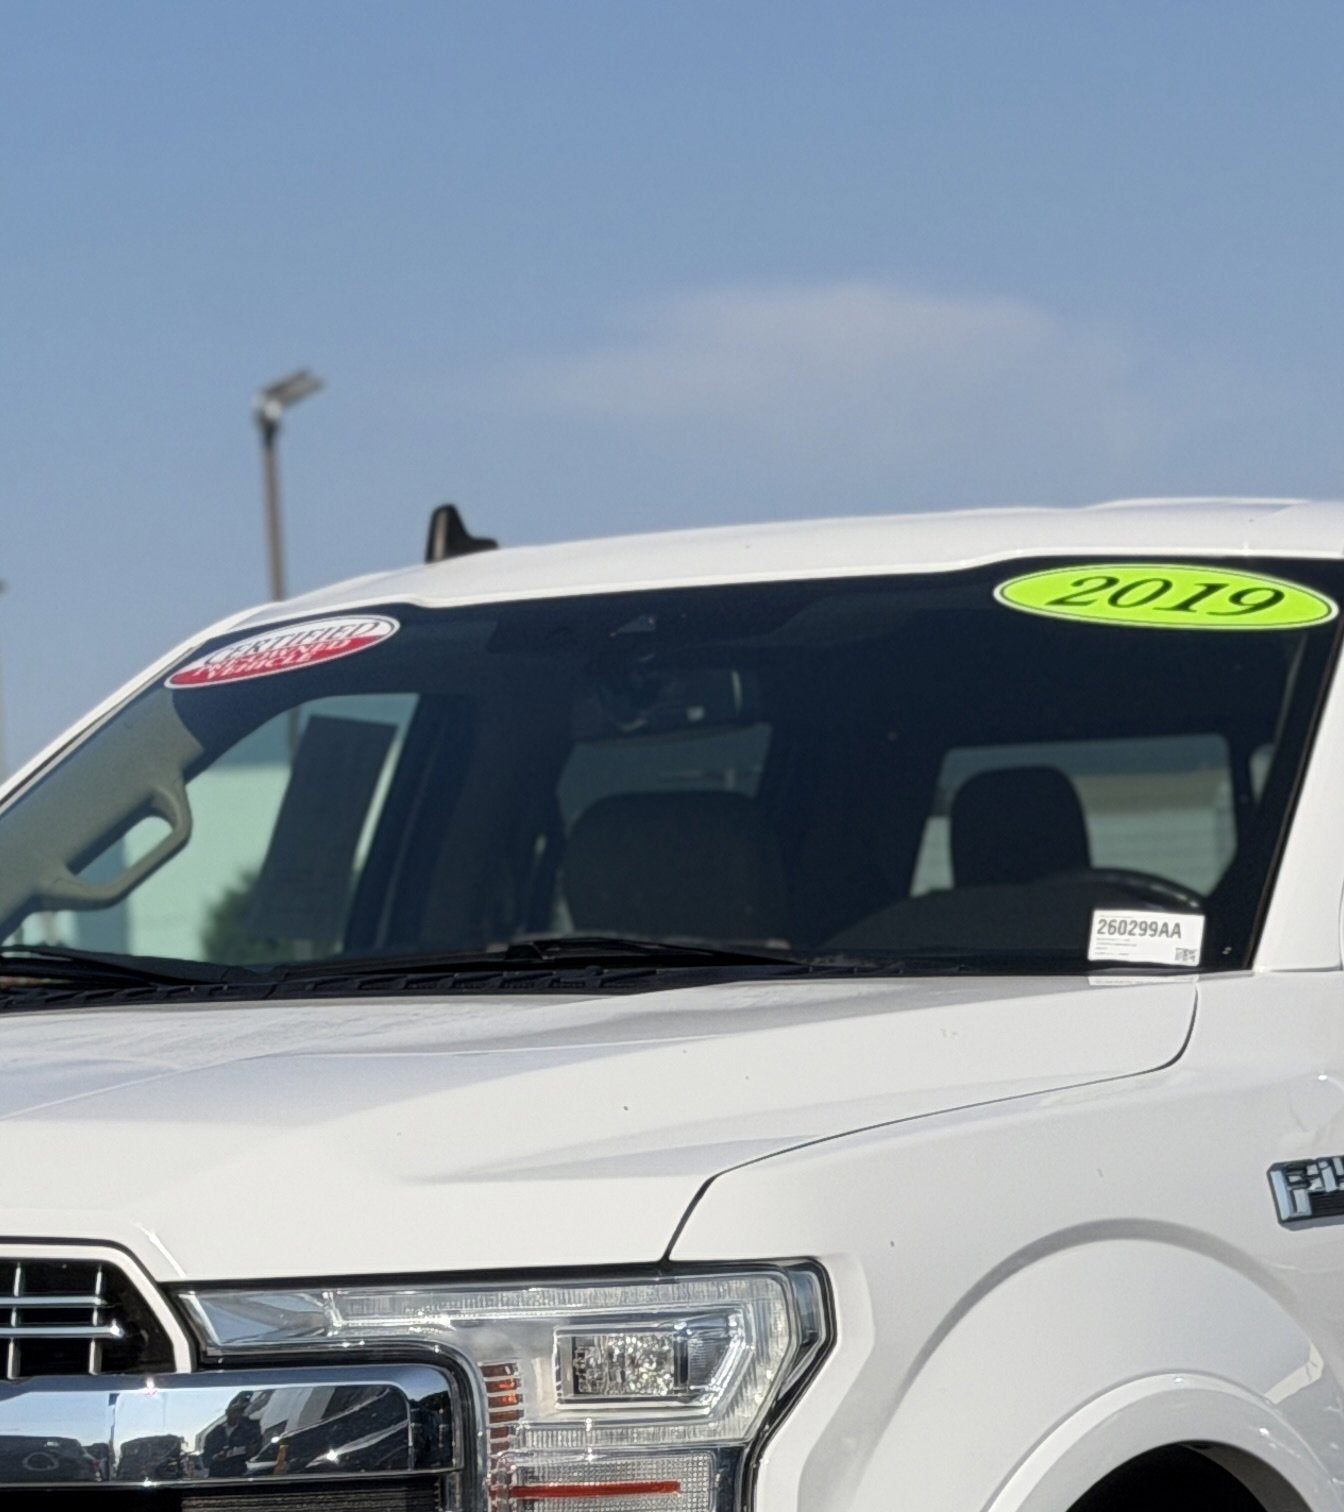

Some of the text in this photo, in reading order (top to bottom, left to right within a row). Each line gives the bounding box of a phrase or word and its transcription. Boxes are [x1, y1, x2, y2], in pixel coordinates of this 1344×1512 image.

[1045, 574, 1286, 617] 2019
[203, 620, 381, 665] CERTIFIED
[206, 652, 313, 680] VEHICLE
[1096, 918, 1182, 939] 260299AA
